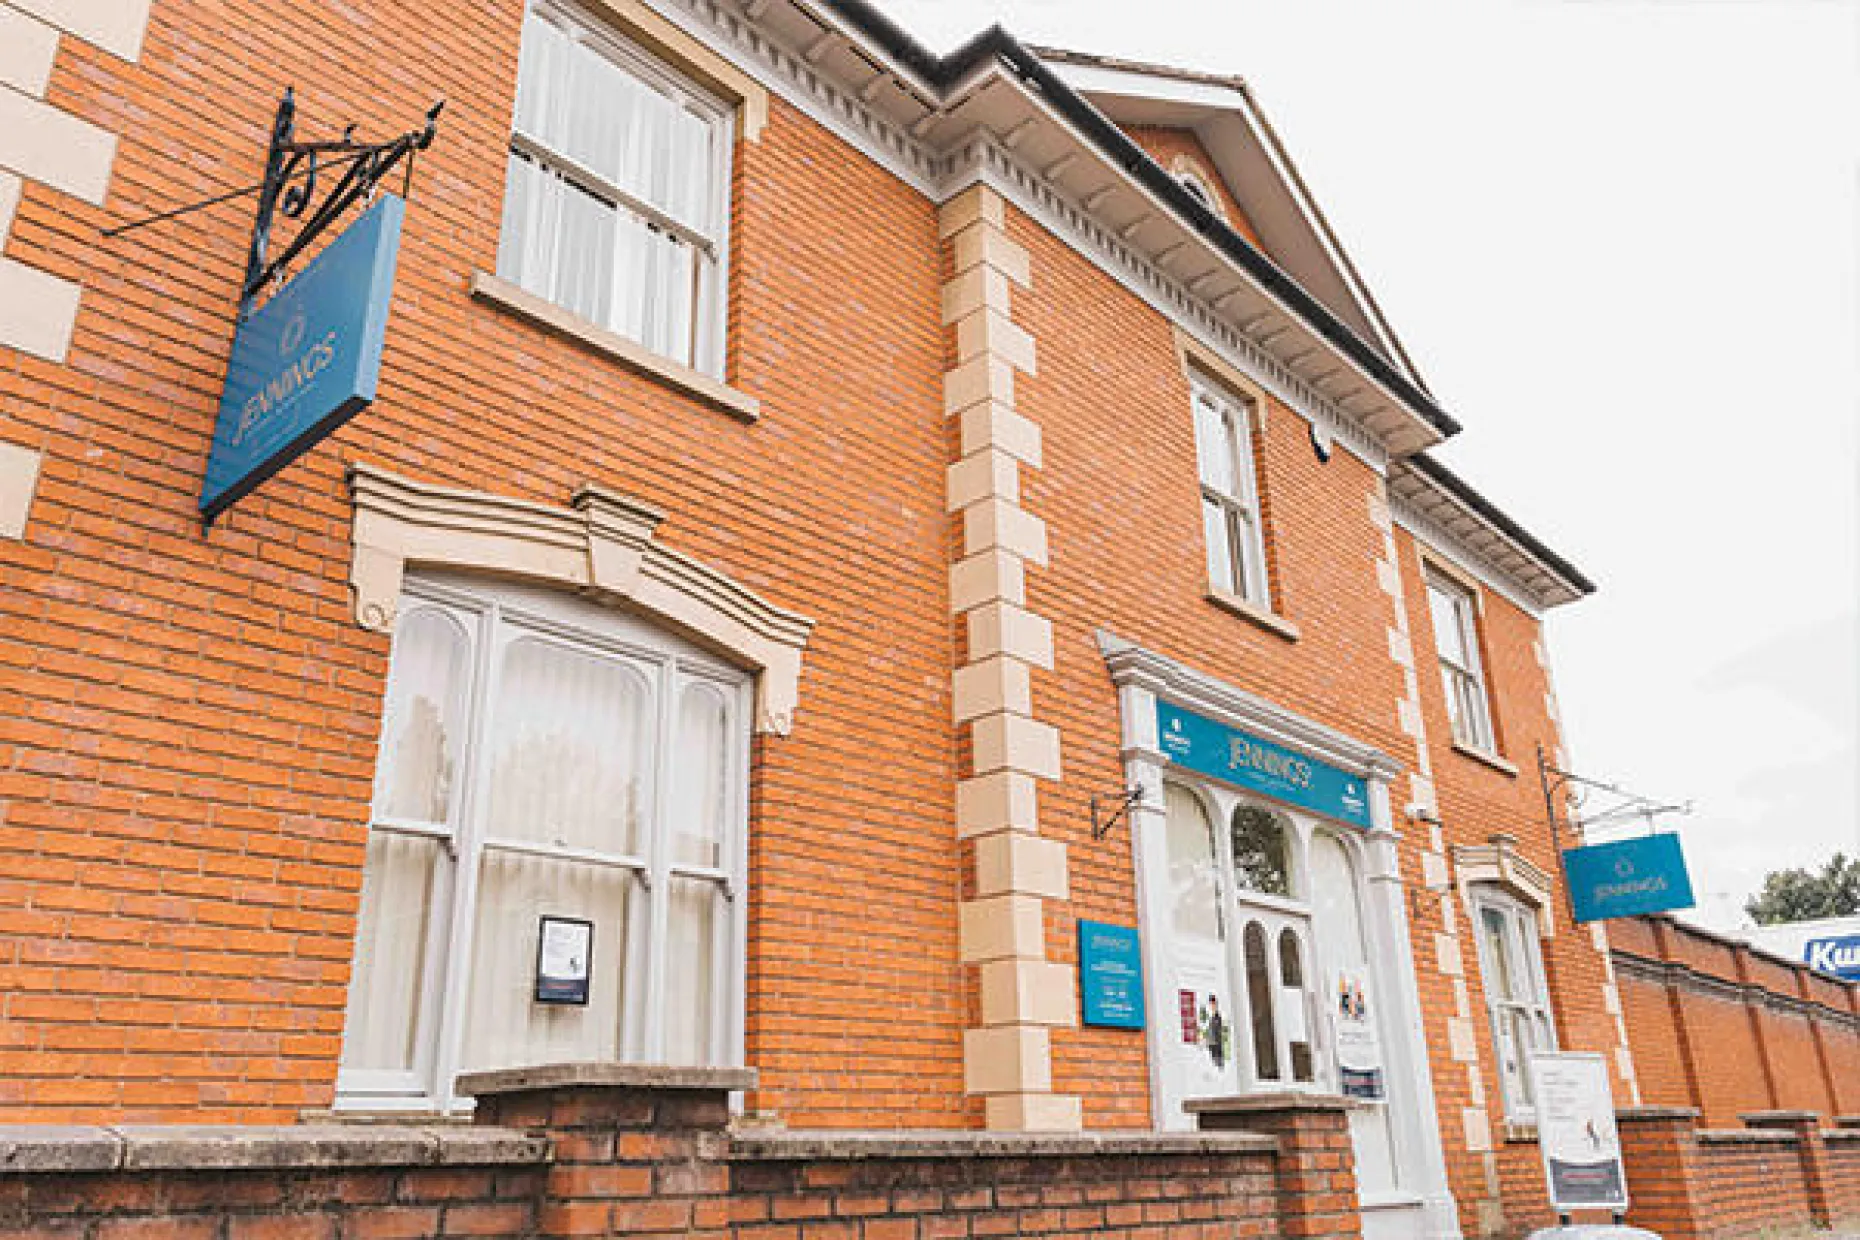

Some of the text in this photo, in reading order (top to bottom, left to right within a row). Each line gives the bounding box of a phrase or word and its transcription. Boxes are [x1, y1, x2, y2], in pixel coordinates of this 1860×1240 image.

[231, 331, 336, 446] JENNINGS
[1227, 734, 1313, 788] JENNINGS
[1593, 874, 1669, 904] JENNINGS
